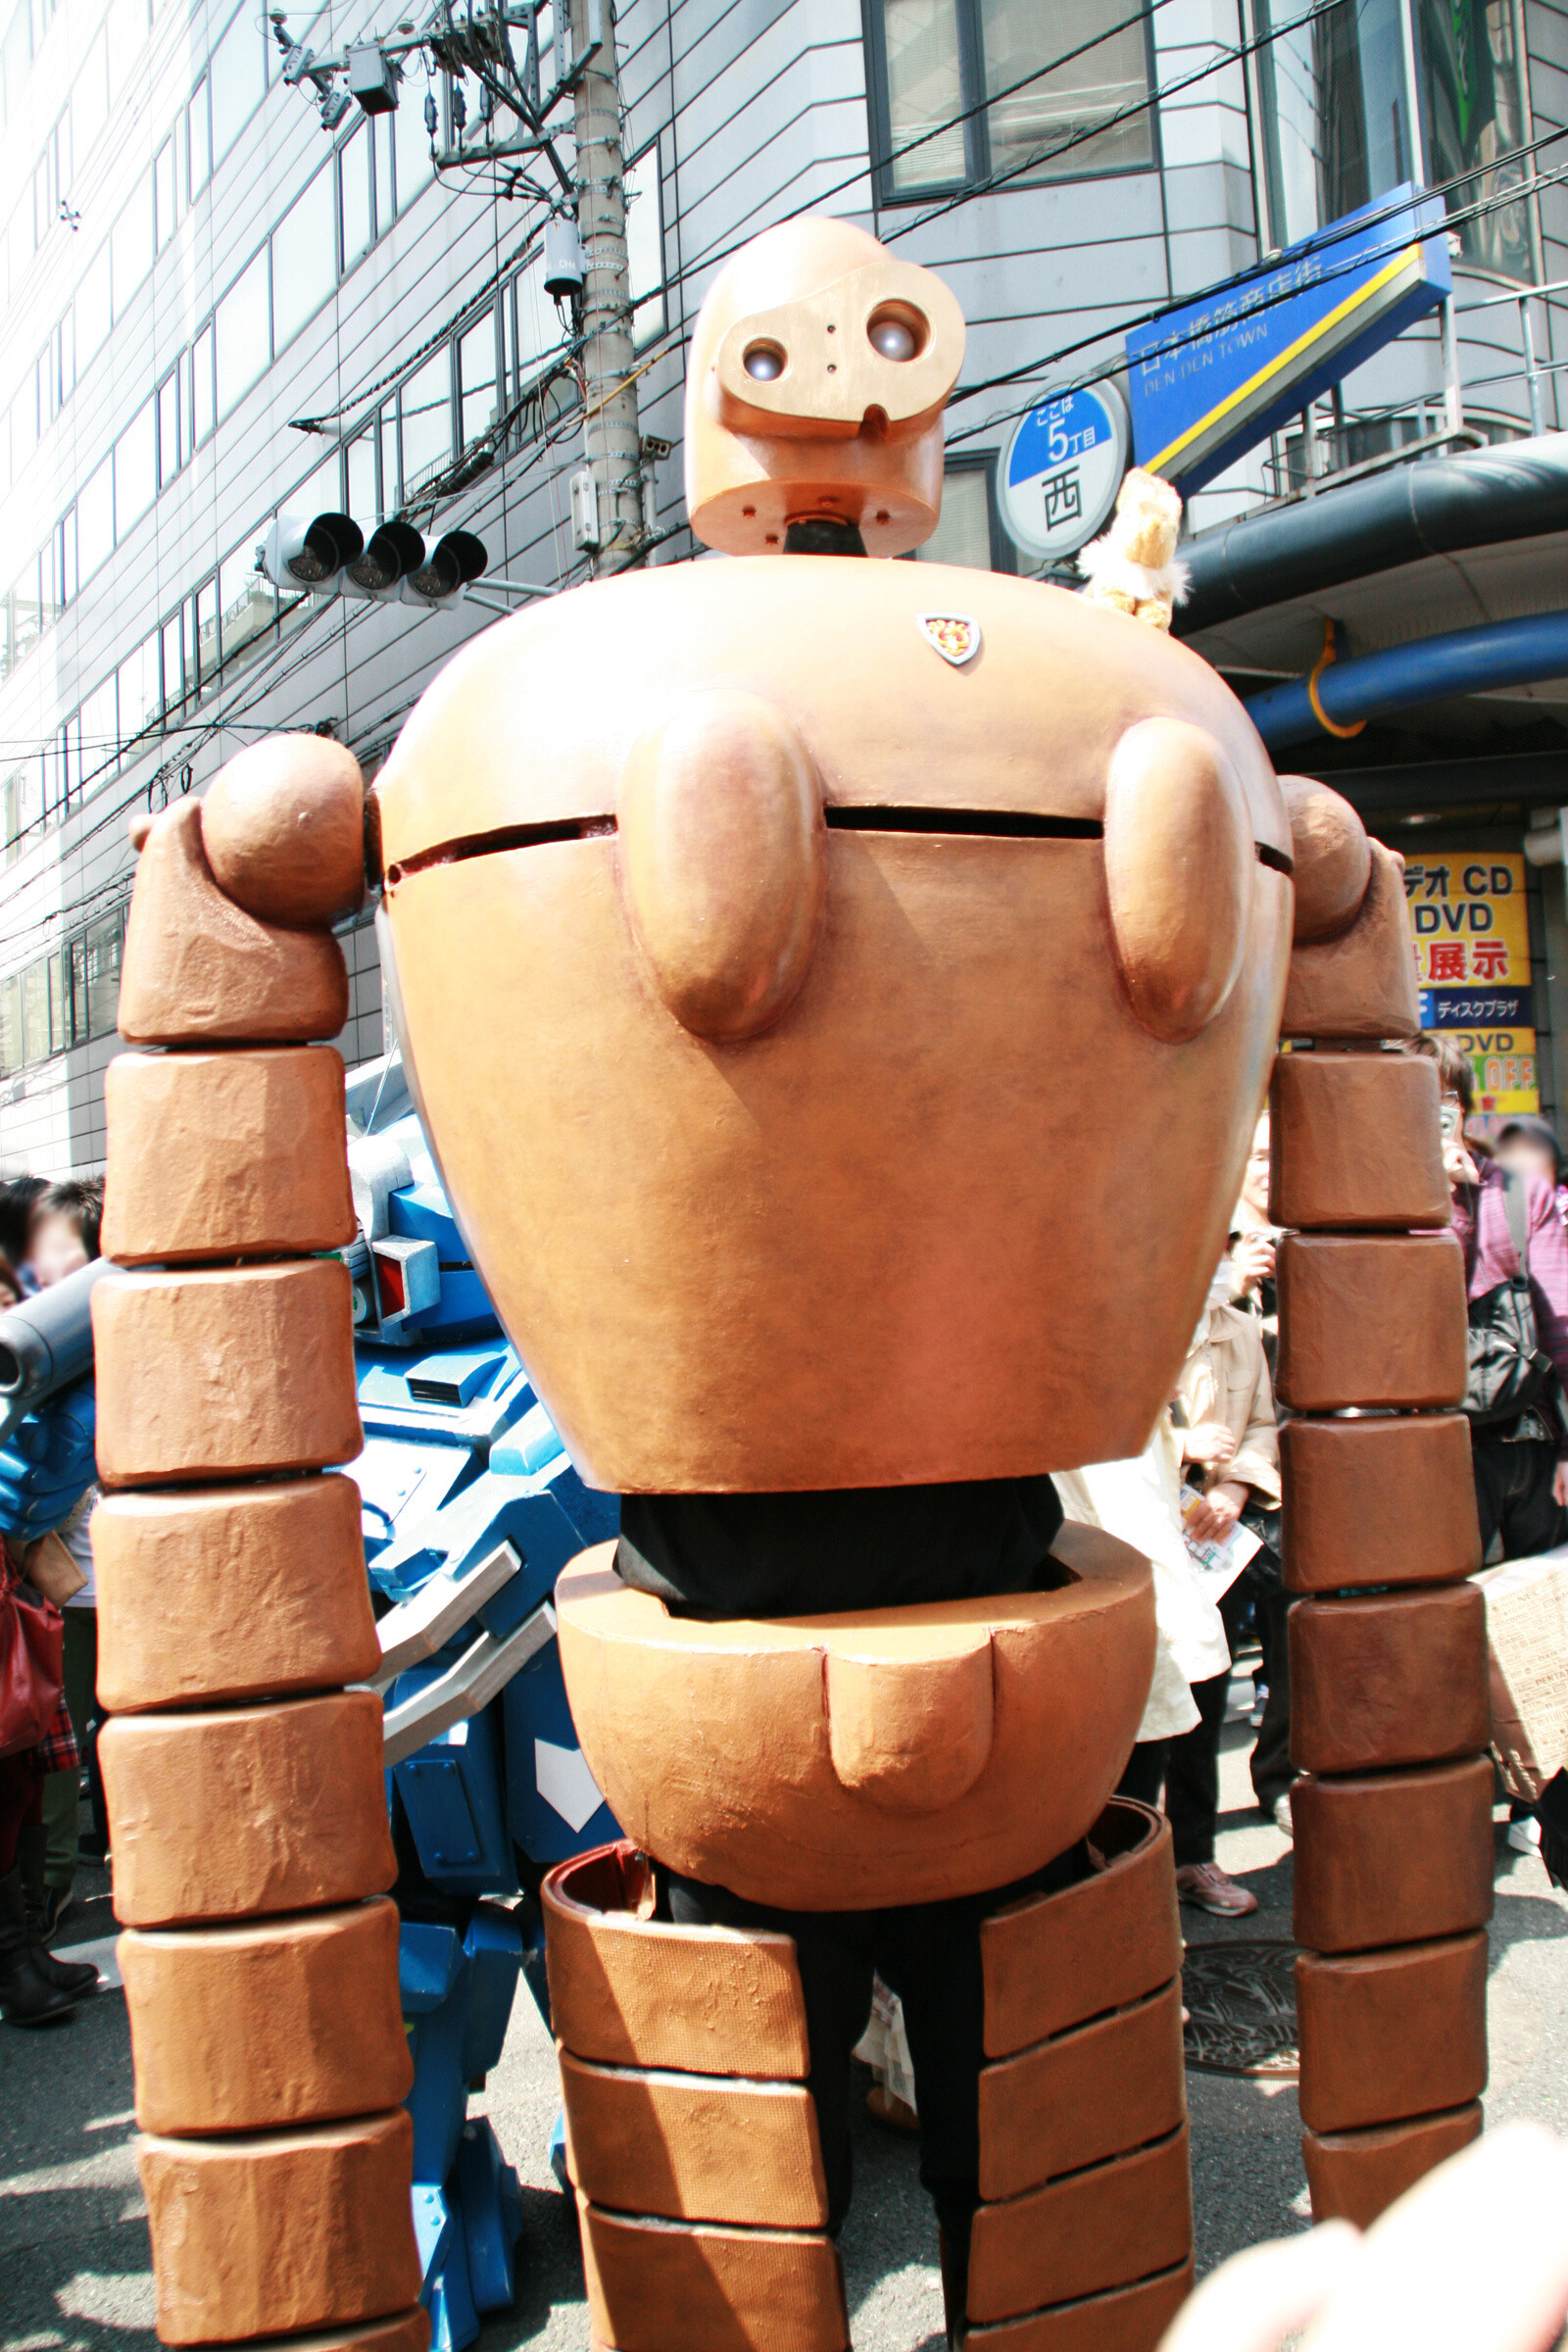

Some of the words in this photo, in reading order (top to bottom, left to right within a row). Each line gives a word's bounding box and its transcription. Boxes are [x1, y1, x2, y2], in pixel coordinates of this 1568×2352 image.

[1218, 323, 1268, 359] TOWN
[1036, 394, 1074, 426] ここは
[1049, 418, 1096, 462] 5丁目
[1042, 465, 1082, 531] 西
[1463, 864, 1513, 897] CD
[1415, 902, 1494, 934] DVD
[1438, 1000, 1519, 1020] ディスクプラザ
[1456, 1033, 1514, 1053] DVD
